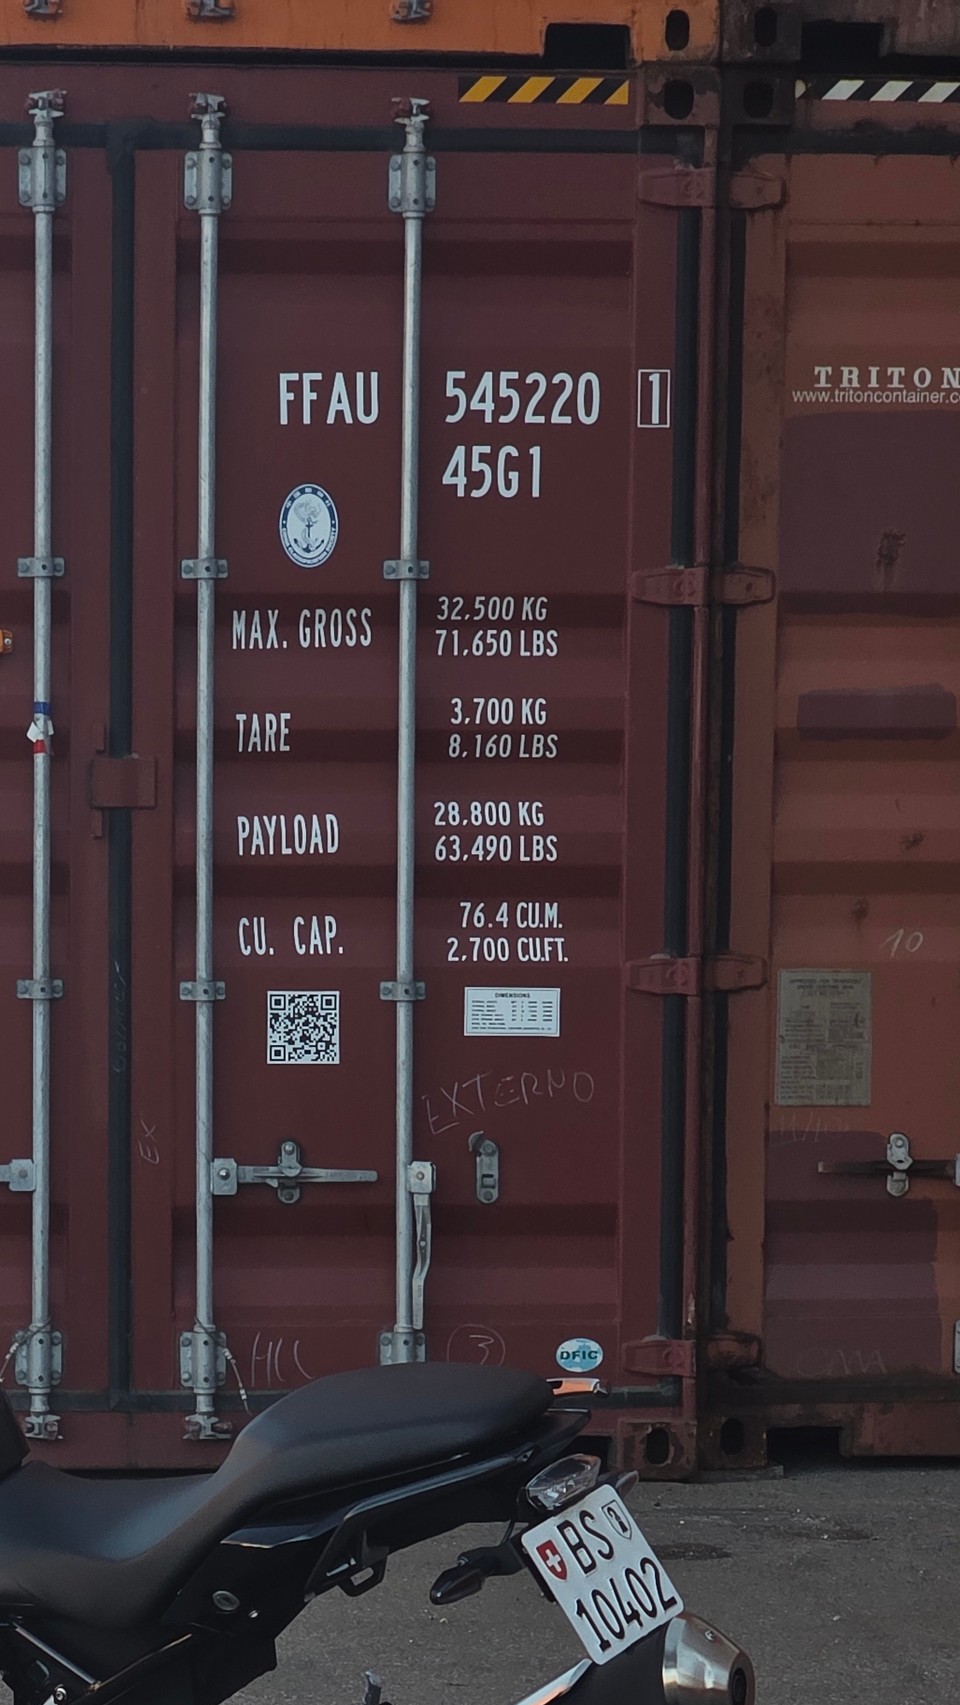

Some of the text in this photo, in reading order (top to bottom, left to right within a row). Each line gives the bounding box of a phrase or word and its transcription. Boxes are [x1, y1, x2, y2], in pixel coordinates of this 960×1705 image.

[814, 366, 960, 389] TRITON
[279, 370, 660, 425] FFAU 545220 1
[790, 388, 960, 405] www.tritoncontainer.c
[442, 445, 541, 498] 45G1
[436, 595, 548, 621] 32,500 KG
[232, 607, 372, 650] MAX. GROSS
[435, 629, 558, 657] 71,650 LBS
[450, 697, 547, 725] 3,700 KG
[235, 712, 291, 753] TARE
[448, 733, 559, 759] 8,160 LBS
[433, 801, 544, 826] 28,800 KG
[237, 813, 339, 856] PAYLOAD
[435, 834, 558, 862] 63,490 LBS
[459, 901, 563, 929] 76.4 CU.M.
[238, 915, 344, 956] CU. CAP.
[447, 937, 569, 962] 2,700 CU.FT.
[884, 927, 924, 958] 10
[559, 1350, 599, 1361] DFIC
[556, 1509, 614, 1575] BS
[575, 1556, 677, 1653] 10402
